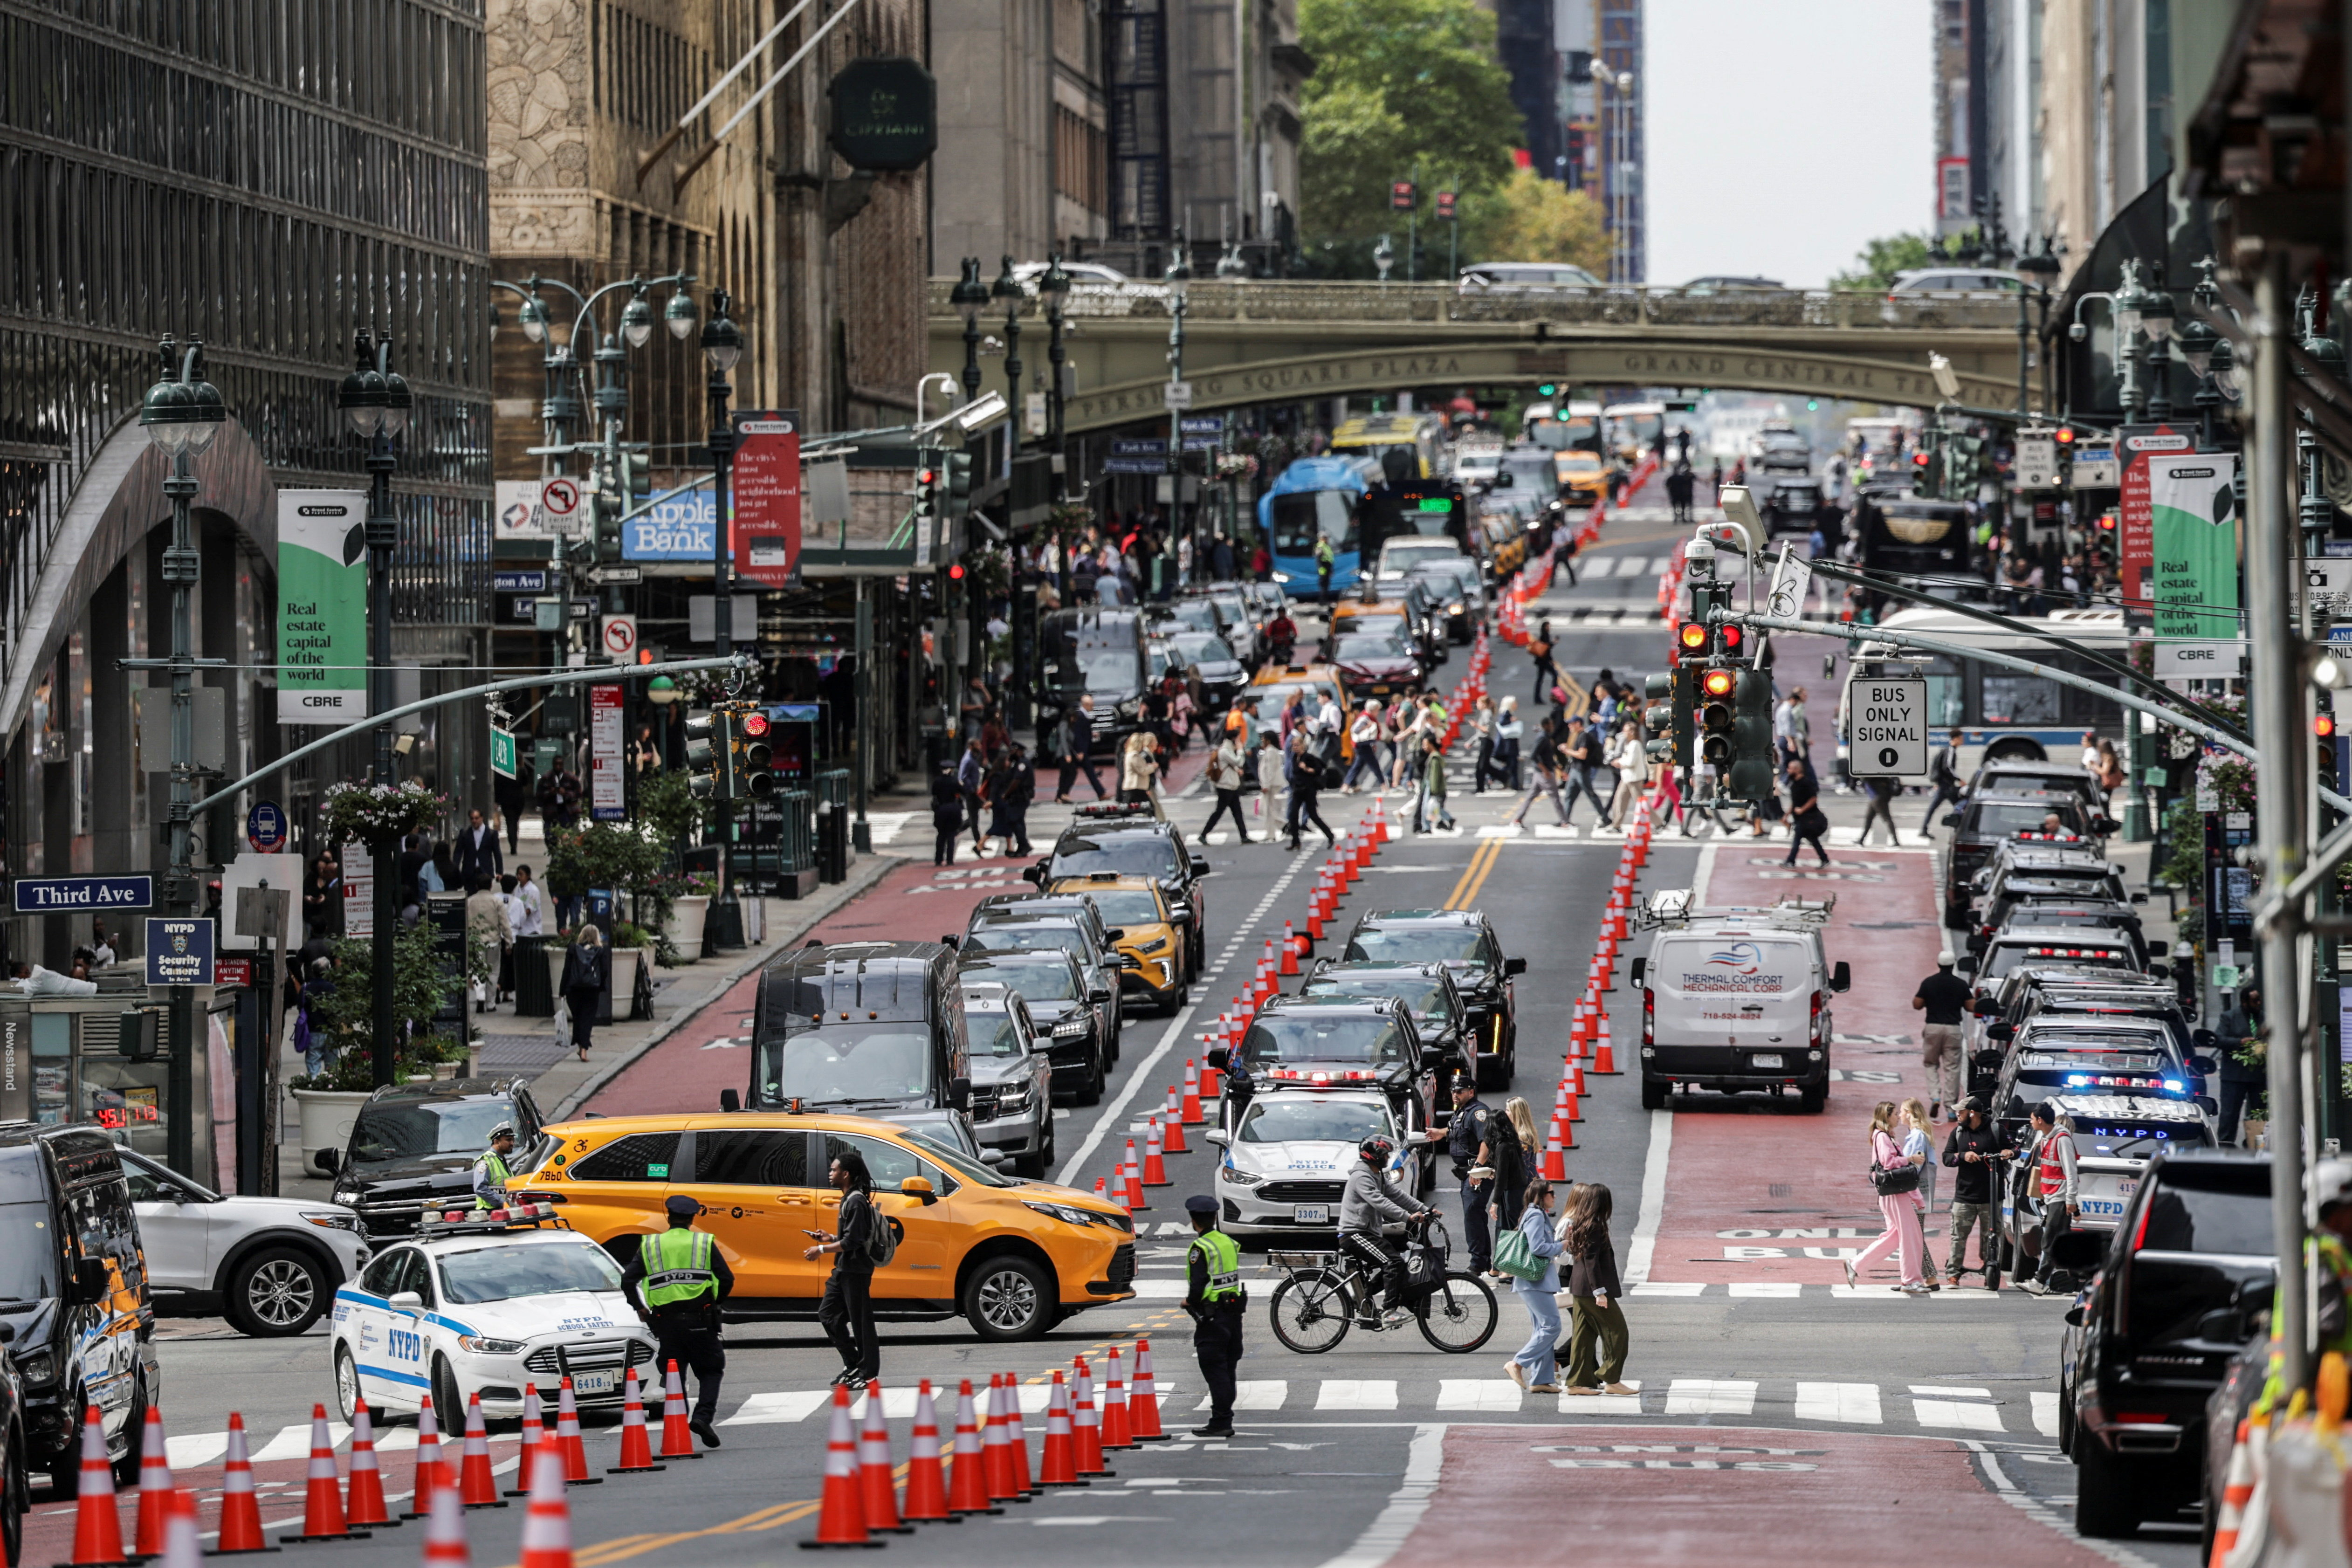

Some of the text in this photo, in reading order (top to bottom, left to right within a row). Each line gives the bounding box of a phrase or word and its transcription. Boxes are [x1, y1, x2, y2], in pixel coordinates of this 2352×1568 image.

[1242, 364, 1351, 392] SQUARE
[1372, 357, 1459, 377] PLAZA
[1624, 355, 1725, 374] GRAND
[1744, 358, 1875, 388] CENTRAL
[740, 452, 755, 462] The
[2128, 472, 2146, 482] The
[634, 525, 712, 552] Bank
[2161, 561, 2188, 573] Real
[519, 576, 541, 588] Ave
[2161, 578, 2198, 588] estate
[2161, 592, 2203, 607] capital
[287, 603, 316, 615] Real
[2161, 608, 2196, 620] of the
[286, 620, 326, 632] estate
[2163, 623, 2198, 635] world
[286, 635, 331, 651] capital
[286, 651, 324, 664] of the
[2177, 650, 2215, 660] CBRE
[287, 668, 325, 681] world
[1872, 688, 1905, 702] BUS
[303, 696, 342, 707] CBRE
[1866, 708, 1911, 722] ONLY
[1858, 727, 1919, 742] SIGNAL
[596, 759, 599, 769] 1
[259, 839, 283, 852] STANDING
[33, 885, 135, 904] Third Ave
[348, 886, 352, 897] 1
[598, 900, 606, 914] P
[165, 923, 195, 933] NYPD
[158, 954, 201, 967] Security
[159, 965, 200, 975] Camera
[1683, 973, 1783, 984] THERMAL COMFORT
[1683, 983, 1782, 993] MECHANICAL CORP.
[6, 1022, 17, 1091] Newsstand
[2084, 1111, 2188, 1122] 415725
[2095, 1128, 2167, 1139] NYPD
[2081, 1201, 2123, 1214] NYPD
[1298, 1210, 1318, 1218] 3307
[665, 1272, 693, 1282] NYPD
[388, 1328, 420, 1362] NYPD
[578, 1377, 602, 1389] 6418
[1530, 1445, 1831, 1456] ONLY
[1547, 1459, 1821, 1472] BUS
